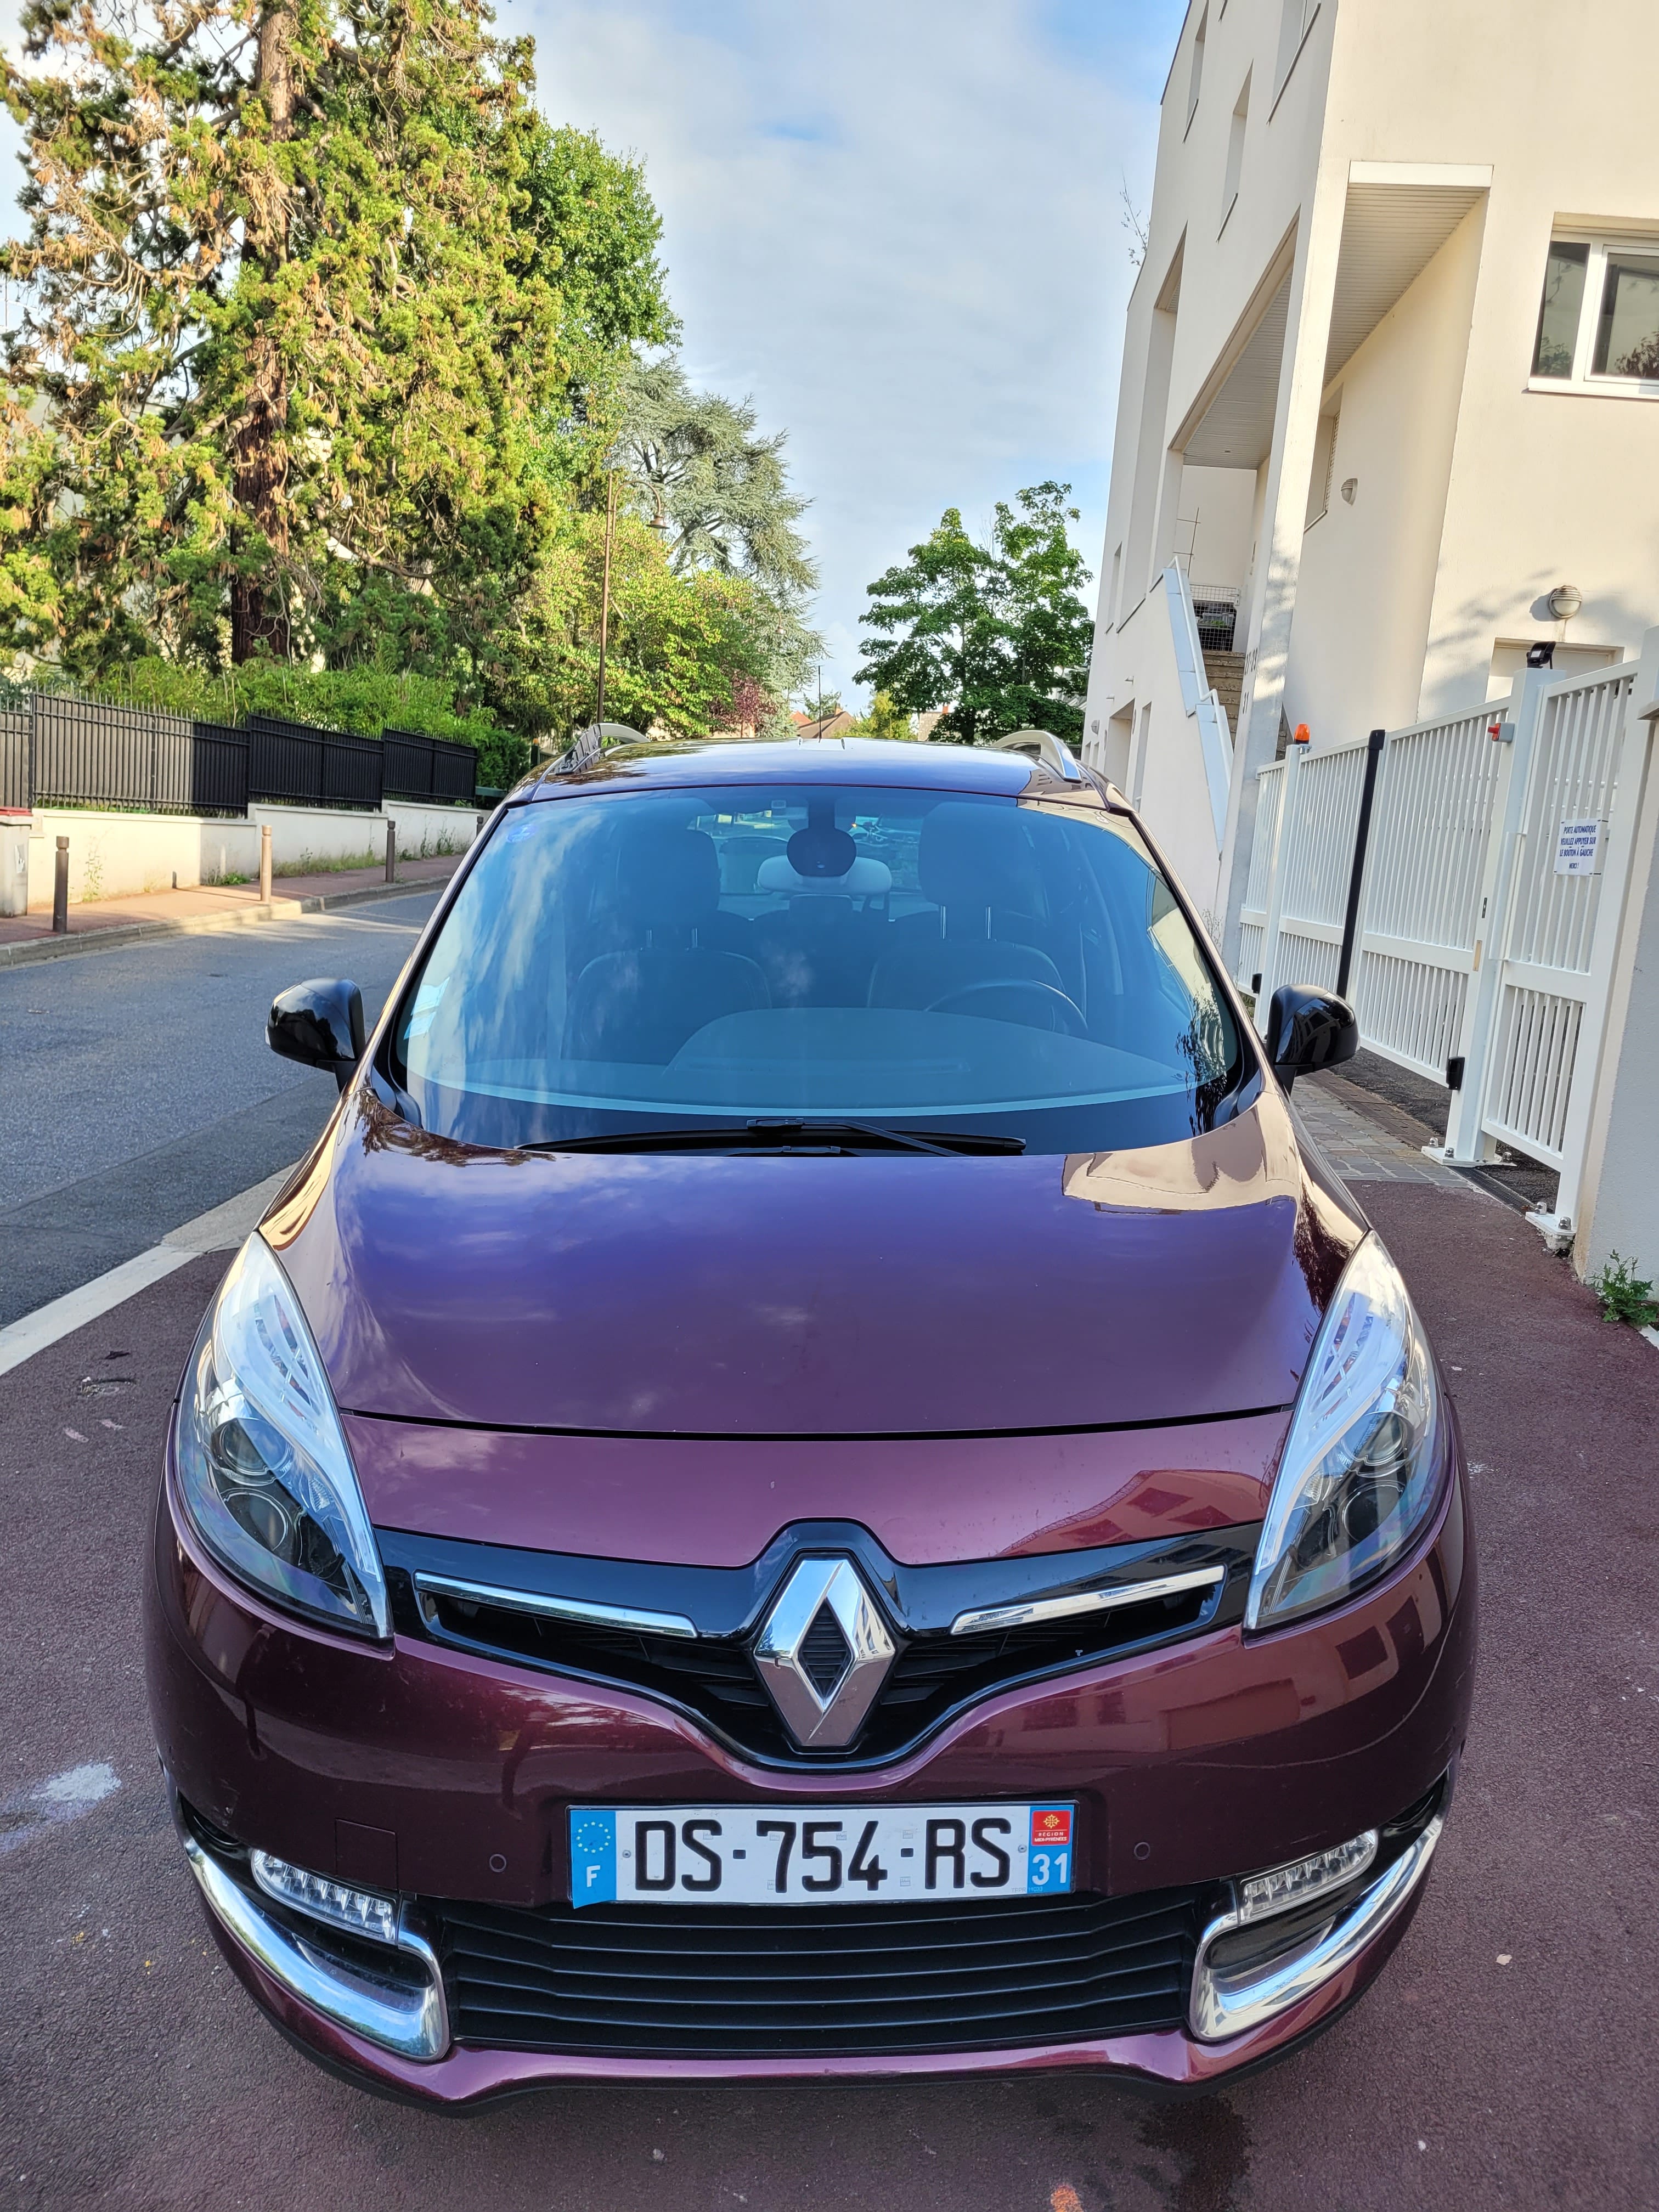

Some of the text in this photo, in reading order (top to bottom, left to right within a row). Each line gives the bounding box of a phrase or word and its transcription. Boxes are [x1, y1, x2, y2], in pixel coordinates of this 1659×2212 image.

[1573, 825, 1596, 835] AUTOMATIQUE
[1575, 837, 1589, 845] APPUYER
[1576, 847, 1579, 856] À
[1579, 848, 1594, 856] GAUCHE
[635, 1818, 1012, 1893] DS-754-RS
[586, 1865, 601, 1888] F
[1032, 1853, 1068, 1886] 31
